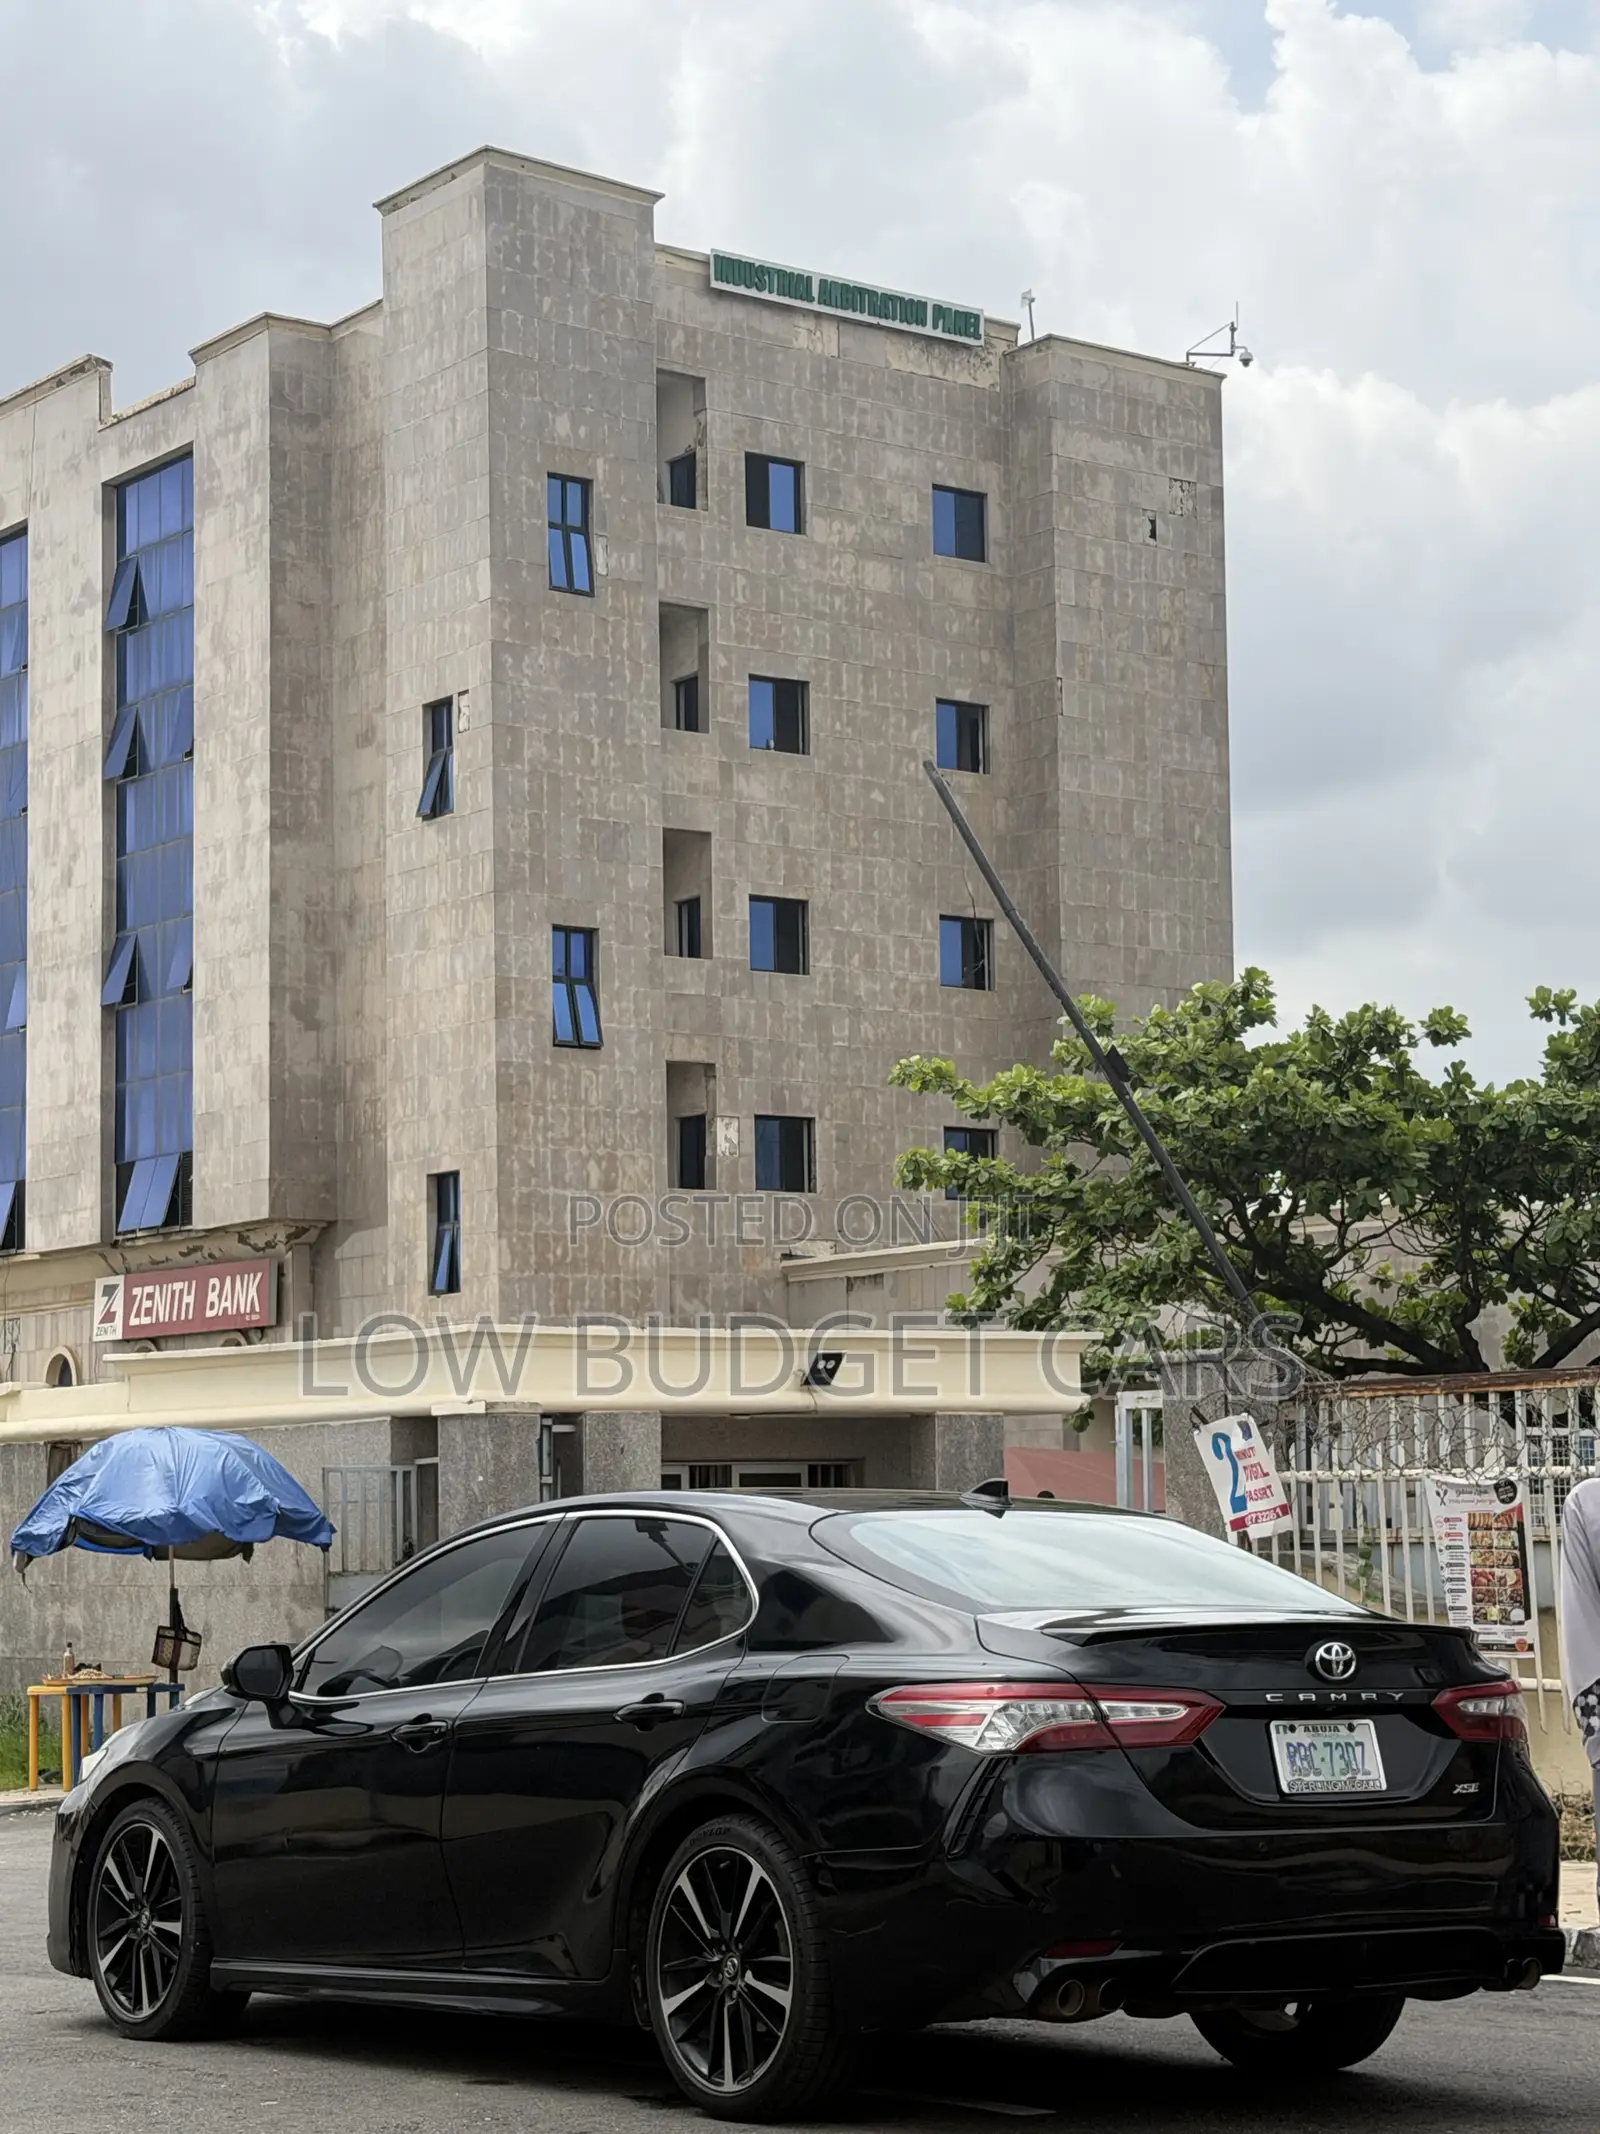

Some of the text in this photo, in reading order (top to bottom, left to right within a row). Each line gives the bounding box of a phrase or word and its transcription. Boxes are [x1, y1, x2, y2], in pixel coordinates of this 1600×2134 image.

[713, 254, 981, 340] INDUSTRIAL ARBITRATION PANEL
[129, 1272, 262, 1326] ZENITH BANK
[95, 1324, 118, 1337] ZENITH
[1211, 1432, 1248, 1514] 2
[1265, 1692, 1404, 1702] CAMRY
[1303, 1725, 1341, 1734] ABUJA
[1288, 1780, 1340, 1792] STERLING
[1452, 1782, 1481, 1794] XSE
